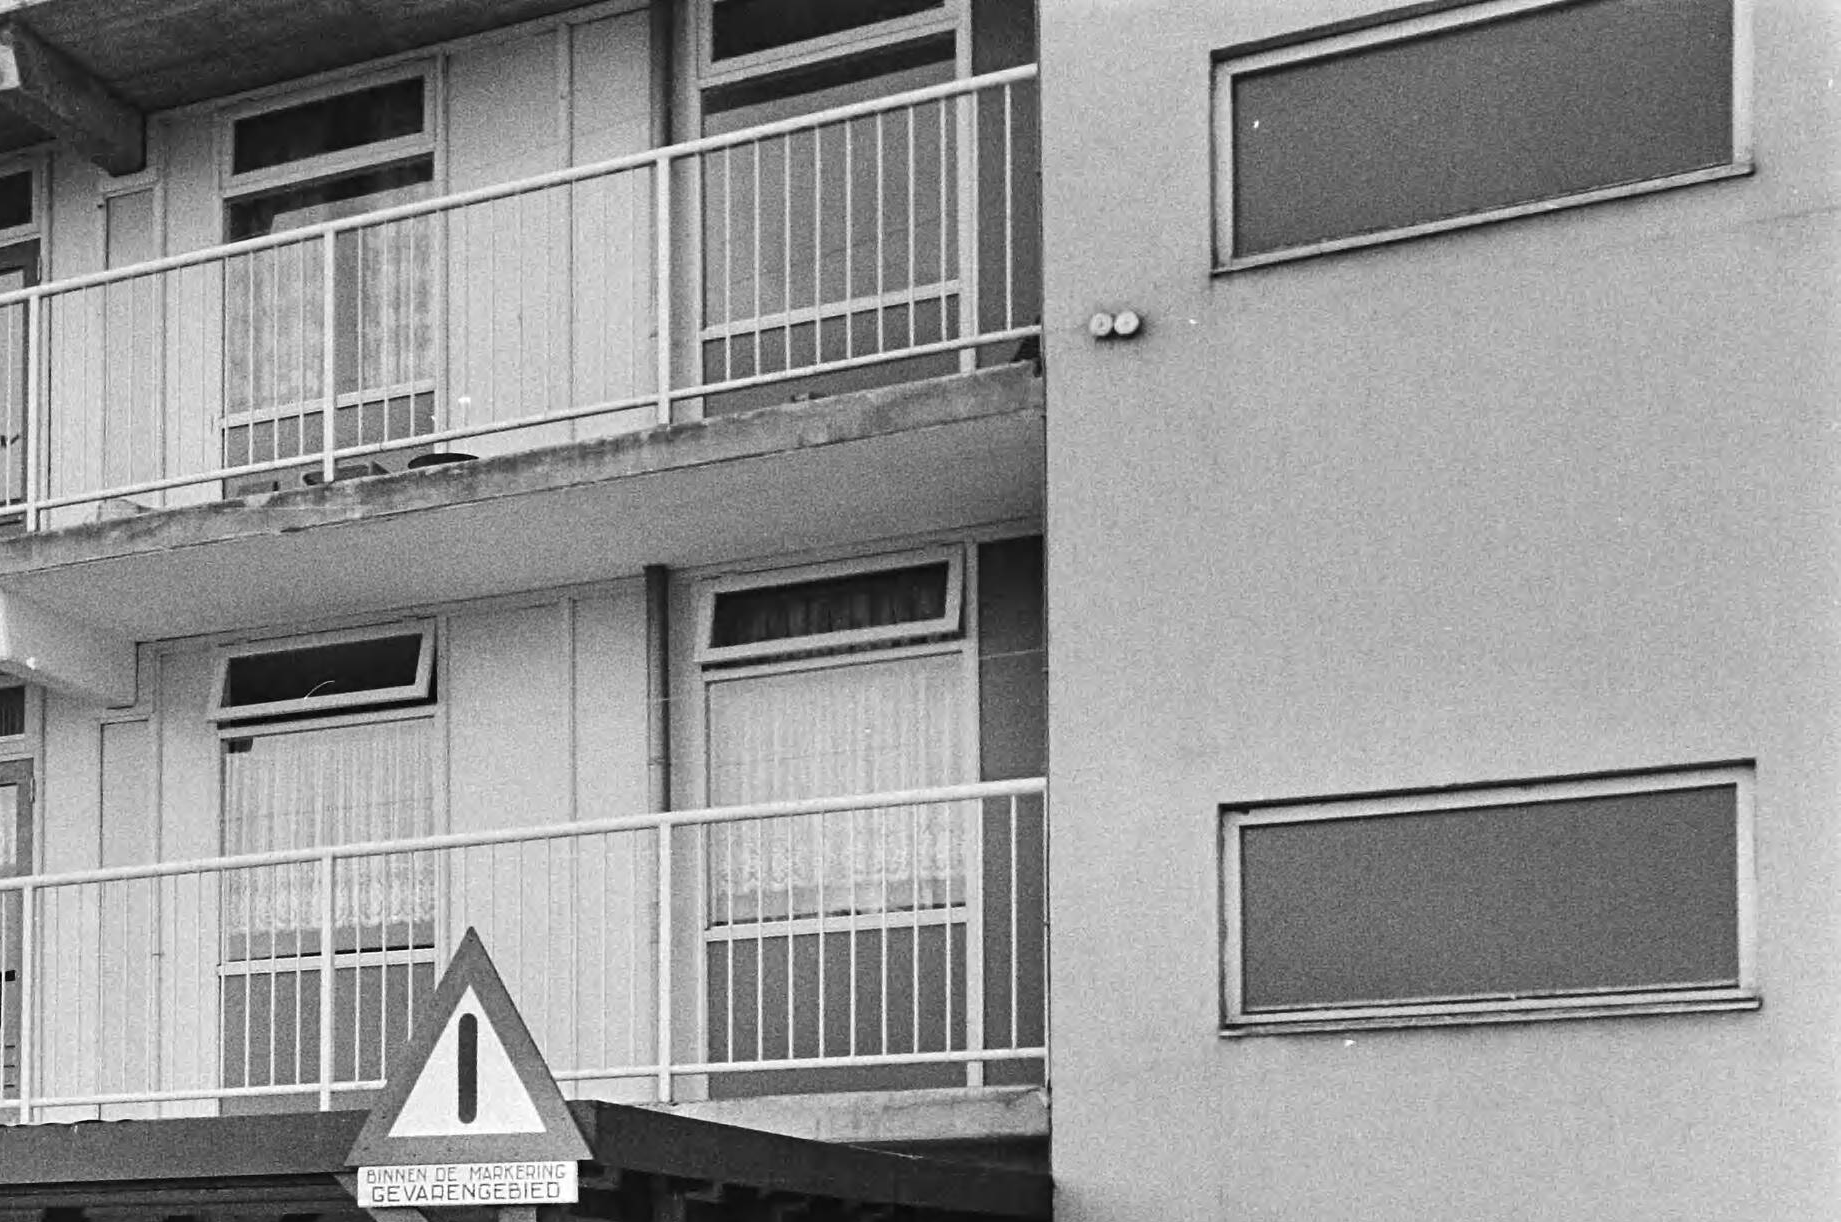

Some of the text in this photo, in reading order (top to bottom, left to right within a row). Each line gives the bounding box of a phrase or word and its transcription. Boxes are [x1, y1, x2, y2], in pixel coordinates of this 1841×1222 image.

[367, 1164, 566, 1184] BINNEN DE MARKERING
[371, 1182, 559, 1203] GEVARENGEBIED
